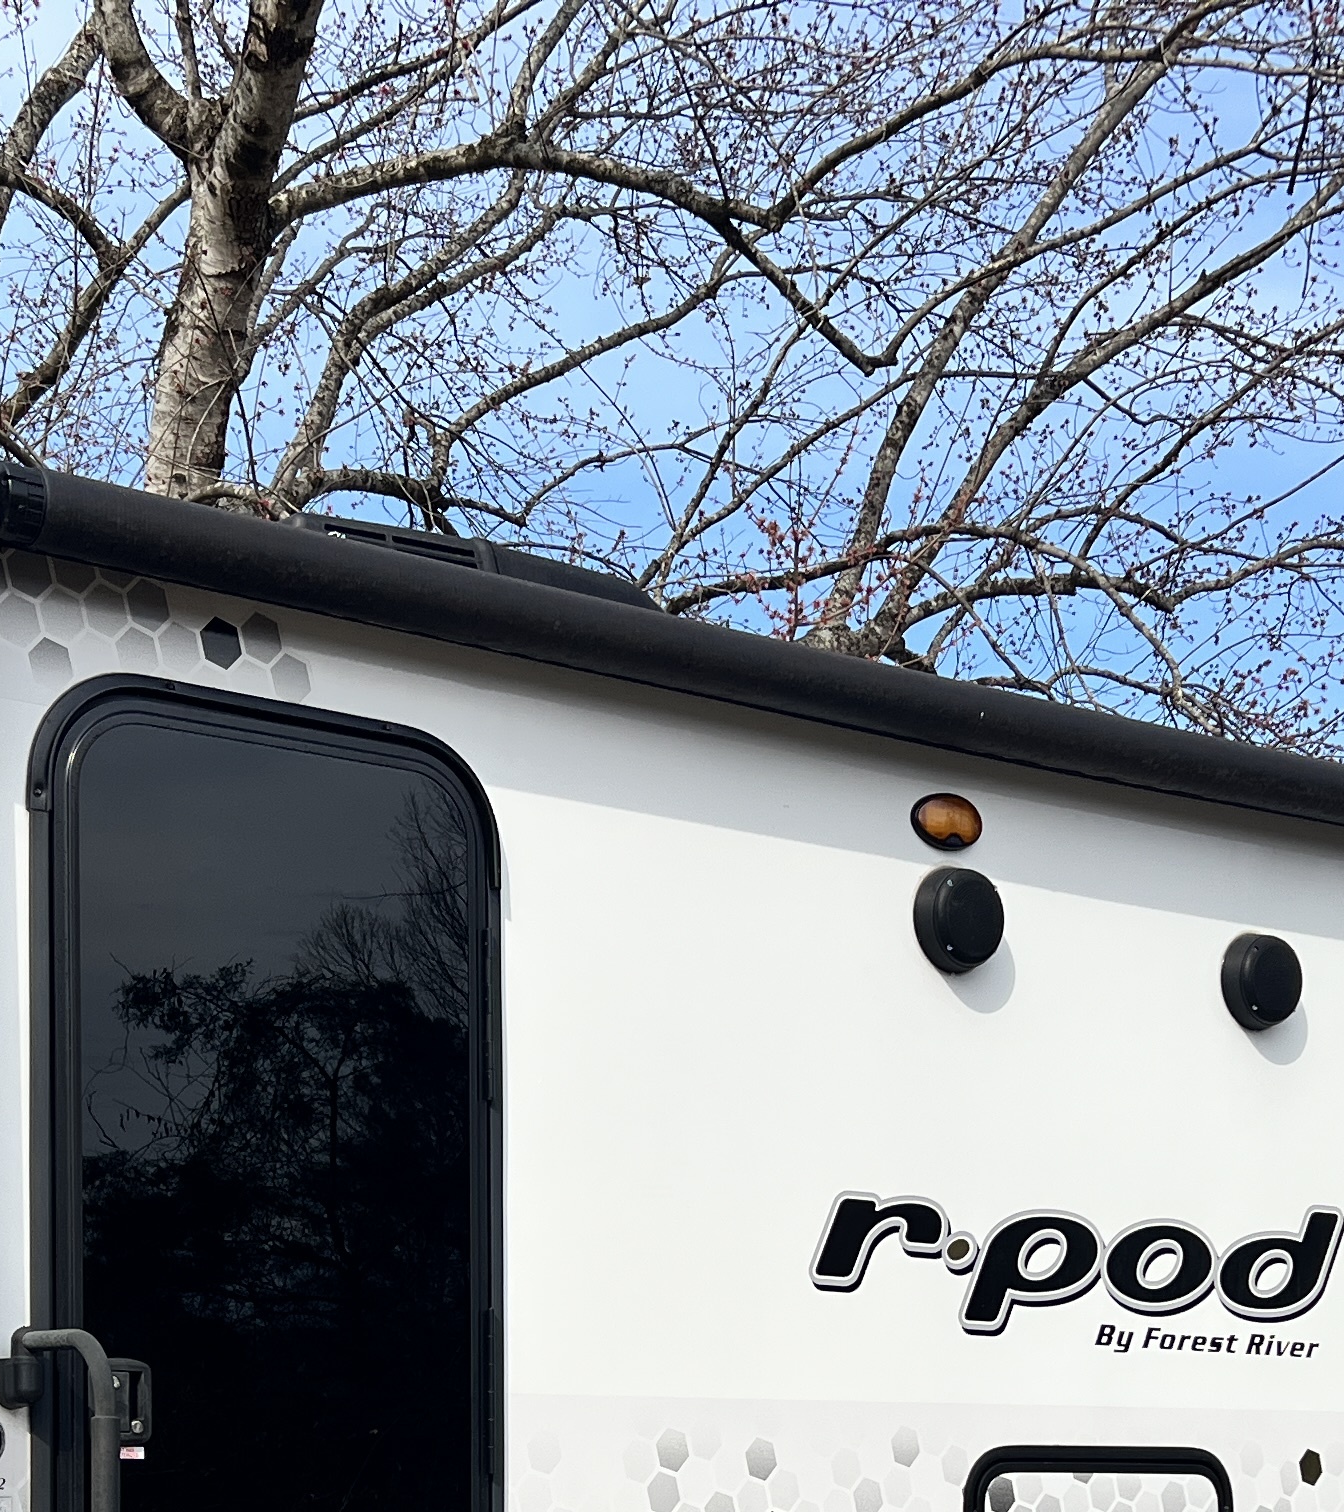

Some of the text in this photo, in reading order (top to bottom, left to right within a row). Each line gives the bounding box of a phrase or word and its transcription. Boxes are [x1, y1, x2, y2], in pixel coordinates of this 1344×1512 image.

[1094, 1324, 1321, 1359] By Forest River
